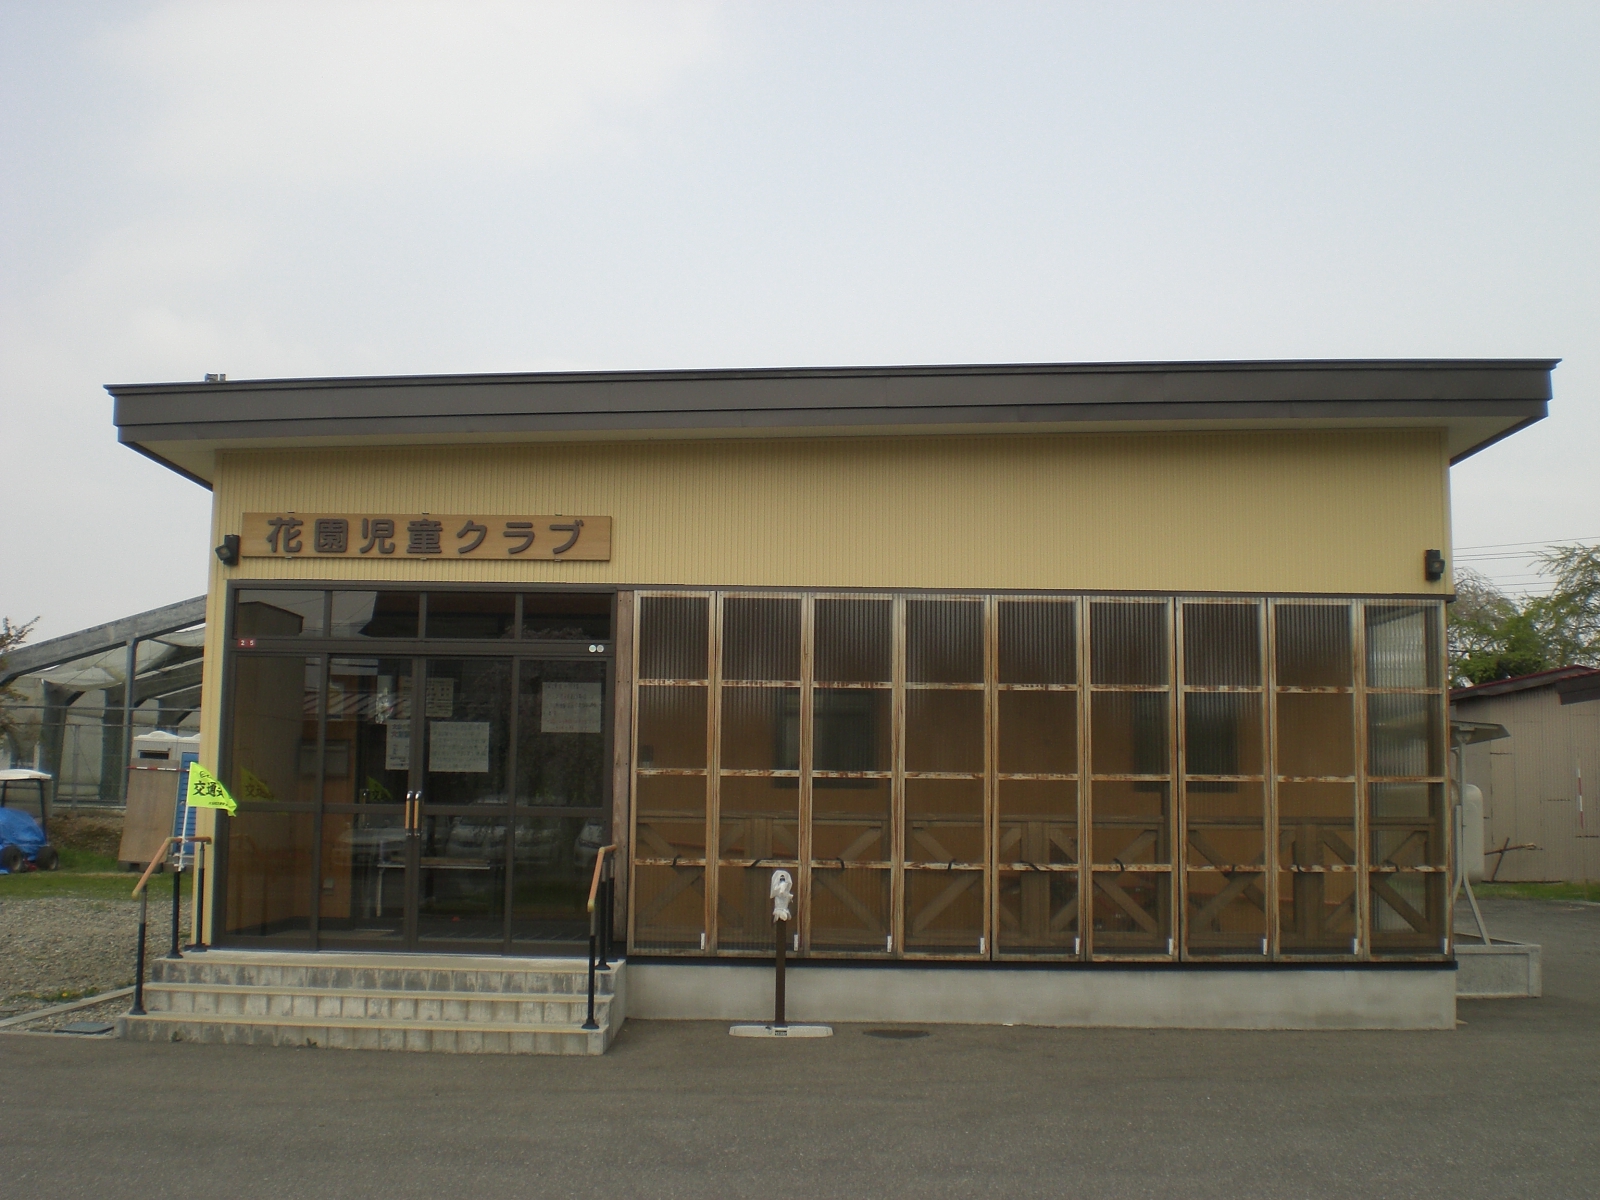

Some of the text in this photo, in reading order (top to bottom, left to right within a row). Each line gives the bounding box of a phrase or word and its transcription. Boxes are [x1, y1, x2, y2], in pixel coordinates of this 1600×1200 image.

[266, 517, 584, 554] 花園児童クラブ
